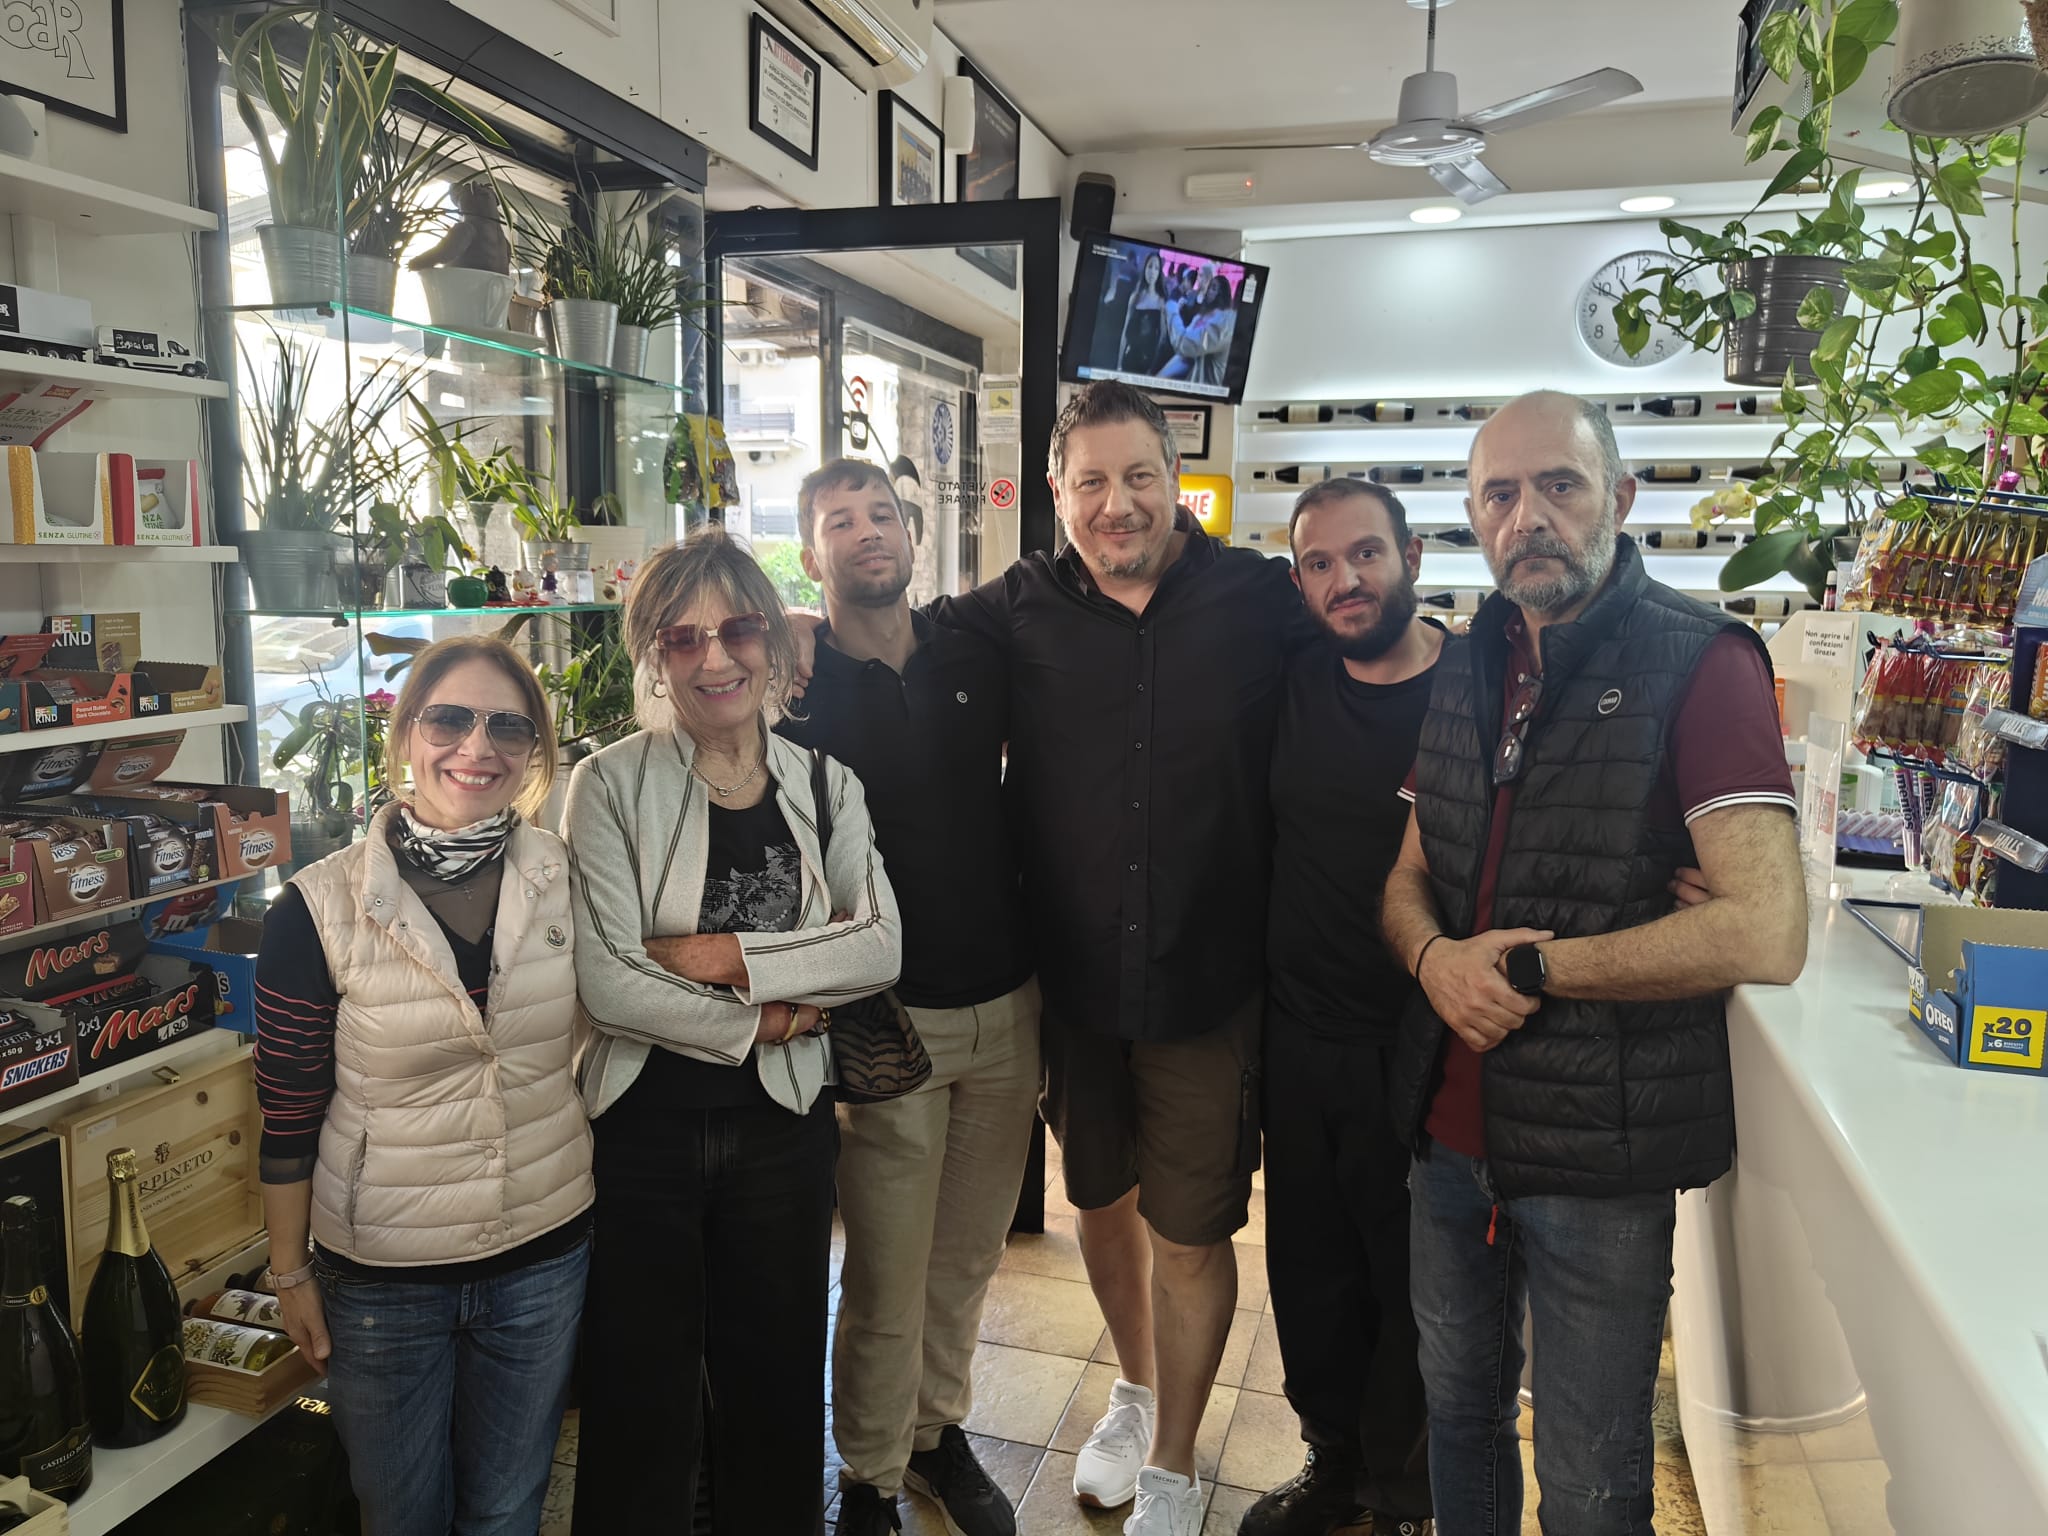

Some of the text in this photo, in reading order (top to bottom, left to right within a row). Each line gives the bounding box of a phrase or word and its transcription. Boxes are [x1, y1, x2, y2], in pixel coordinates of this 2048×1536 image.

[1637, 257, 1651, 272] 12
[1616, 266, 1626, 279] 11
[1597, 282, 1612, 296] 10
[1588, 303, 1598, 317] 9
[1594, 325, 1604, 339] 8
[1654, 340, 1664, 355] 5
[52, 619, 77, 634] BE-
[1805, 630, 1818, 638] Non
[1820, 632, 1841, 640] aprire
[1809, 640, 1843, 649] confezioni
[1814, 648, 1836, 656] Grazie
[139, 703, 159, 712] KIND
[35, 714, 58, 724] KIND
[35, 755, 81, 773] Fitness
[115, 760, 152, 775] Fitness
[1896, 774, 1915, 830] mentos
[239, 839, 274, 858] Fitness
[1995, 833, 2024, 853] HALLS
[52, 843, 79, 860] ness
[154, 848, 185, 864] Fitness
[69, 871, 105, 891] Fitness
[150, 875, 171, 886] PROTEIN
[25, 931, 110, 988] Mars
[90, 984, 199, 1060] Mars
[1925, 1003, 1954, 1034] OREO
[1983, 1016, 2032, 1036] x20
[1987, 1039, 2003, 1048] x6
[3, 1049, 68, 1088] SNICKERS
[138, 1150, 213, 1196] RPINETO
[40, 1450, 76, 1471] CASTELLO
